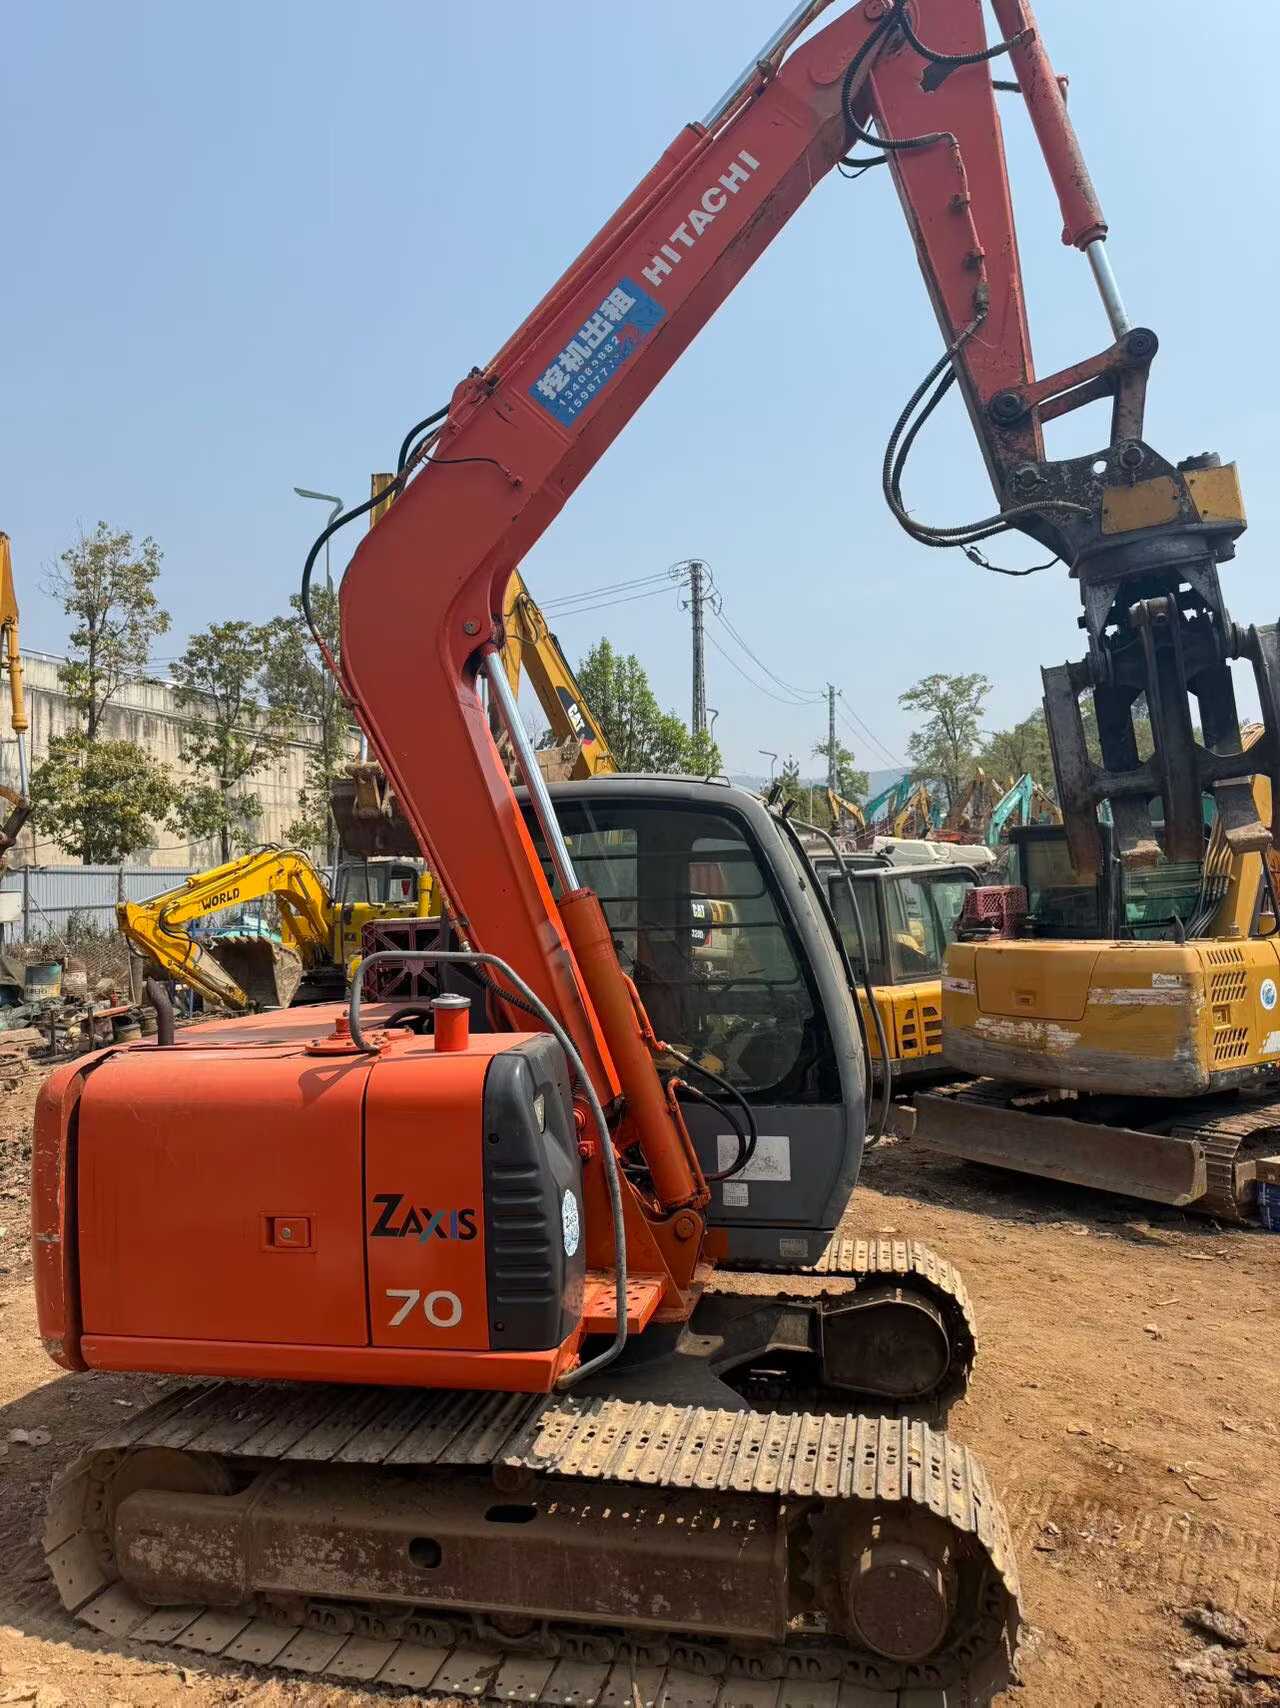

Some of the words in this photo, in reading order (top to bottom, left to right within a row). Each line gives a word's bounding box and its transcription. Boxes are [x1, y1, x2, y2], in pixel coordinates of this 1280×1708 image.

[641, 150, 760, 287] HITACHI
[536, 287, 637, 400] 挖机出租
[568, 703, 585, 732] CAT
[201, 887, 240, 910] WORLD
[692, 903, 705, 918] CAT
[370, 1193, 478, 1243] ZAXIS
[386, 1289, 463, 1328] 70
